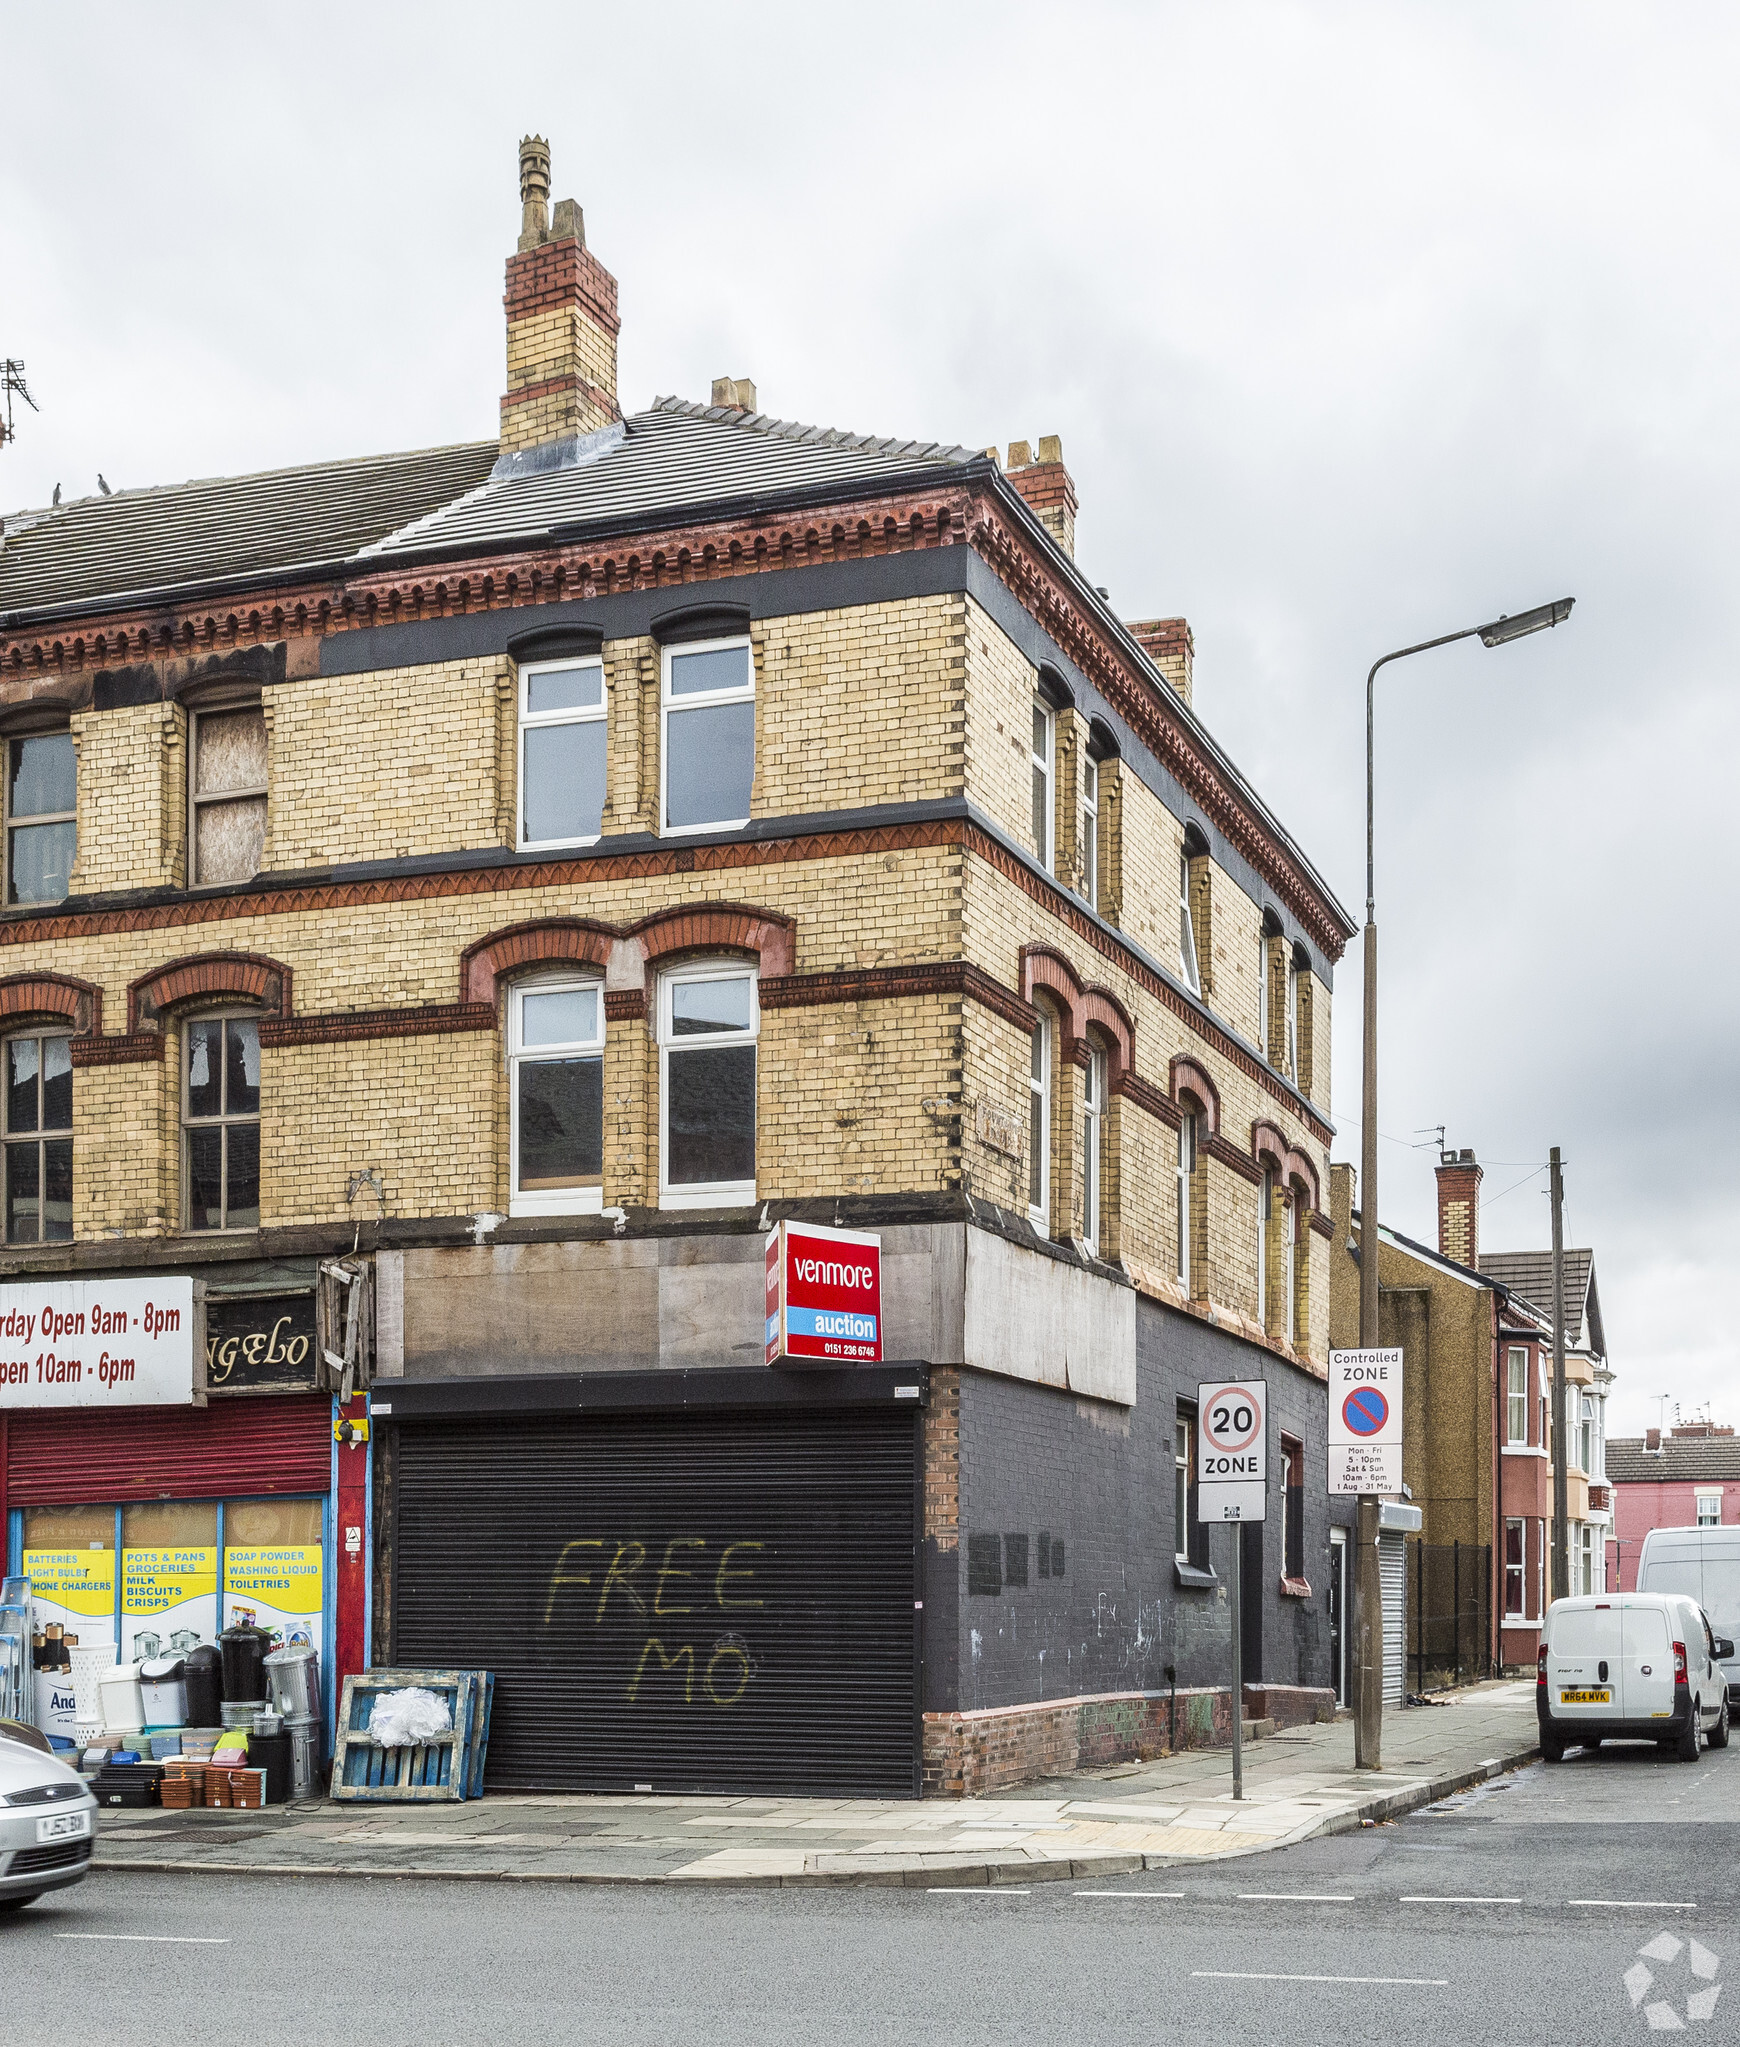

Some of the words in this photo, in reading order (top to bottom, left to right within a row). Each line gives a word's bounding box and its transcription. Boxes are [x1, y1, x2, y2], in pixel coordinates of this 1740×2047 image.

[794, 1257, 873, 1290] venmore
[41, 1306, 85, 1343] Open
[91, 1304, 127, 1334] 9am
[144, 1302, 180, 1340] 8pm
[815, 1314, 873, 1338] auction
[824, 1343, 842, 1354] 0151
[843, 1344, 857, 1356] 236
[858, 1346, 875, 1357] 6746
[1334, 1352, 1398, 1364] Controlled
[36, 1353, 81, 1383] 10am
[99, 1352, 135, 1389] 6pm
[1343, 1367, 1388, 1380] ZONE
[1213, 1406, 1252, 1433] 20
[1205, 1457, 1258, 1474] ZONE
[1343, 1483, 1358, 1491] Aug
[1377, 1483, 1393, 1491] May
[28, 1555, 78, 1564] BATTERIES
[127, 1553, 158, 1562] POTS
[162, 1553, 170, 1562] &
[174, 1552, 206, 1561] PANS
[229, 1552, 257, 1561] SOAP
[260, 1551, 305, 1561] POWDER
[28, 1568, 55, 1577] LIGHT
[57, 1568, 87, 1578] BULBS
[127, 1564, 196, 1573] GROCERIES
[229, 1566, 279, 1575] WASHING
[282, 1565, 318, 1575] LIQUID
[127, 1576, 156, 1585] MILK
[229, 1579, 290, 1589] TOILETRIES
[545, 1539, 764, 1623] FREE
[61, 1582, 112, 1591] CHARGERS
[127, 1587, 182, 1596] BISCUITS
[126, 1598, 169, 1607] CRISPS
[627, 1638, 749, 1704] MO
[1564, 1691, 1587, 1701] WR64
[1588, 1691, 1606, 1701] MVK
